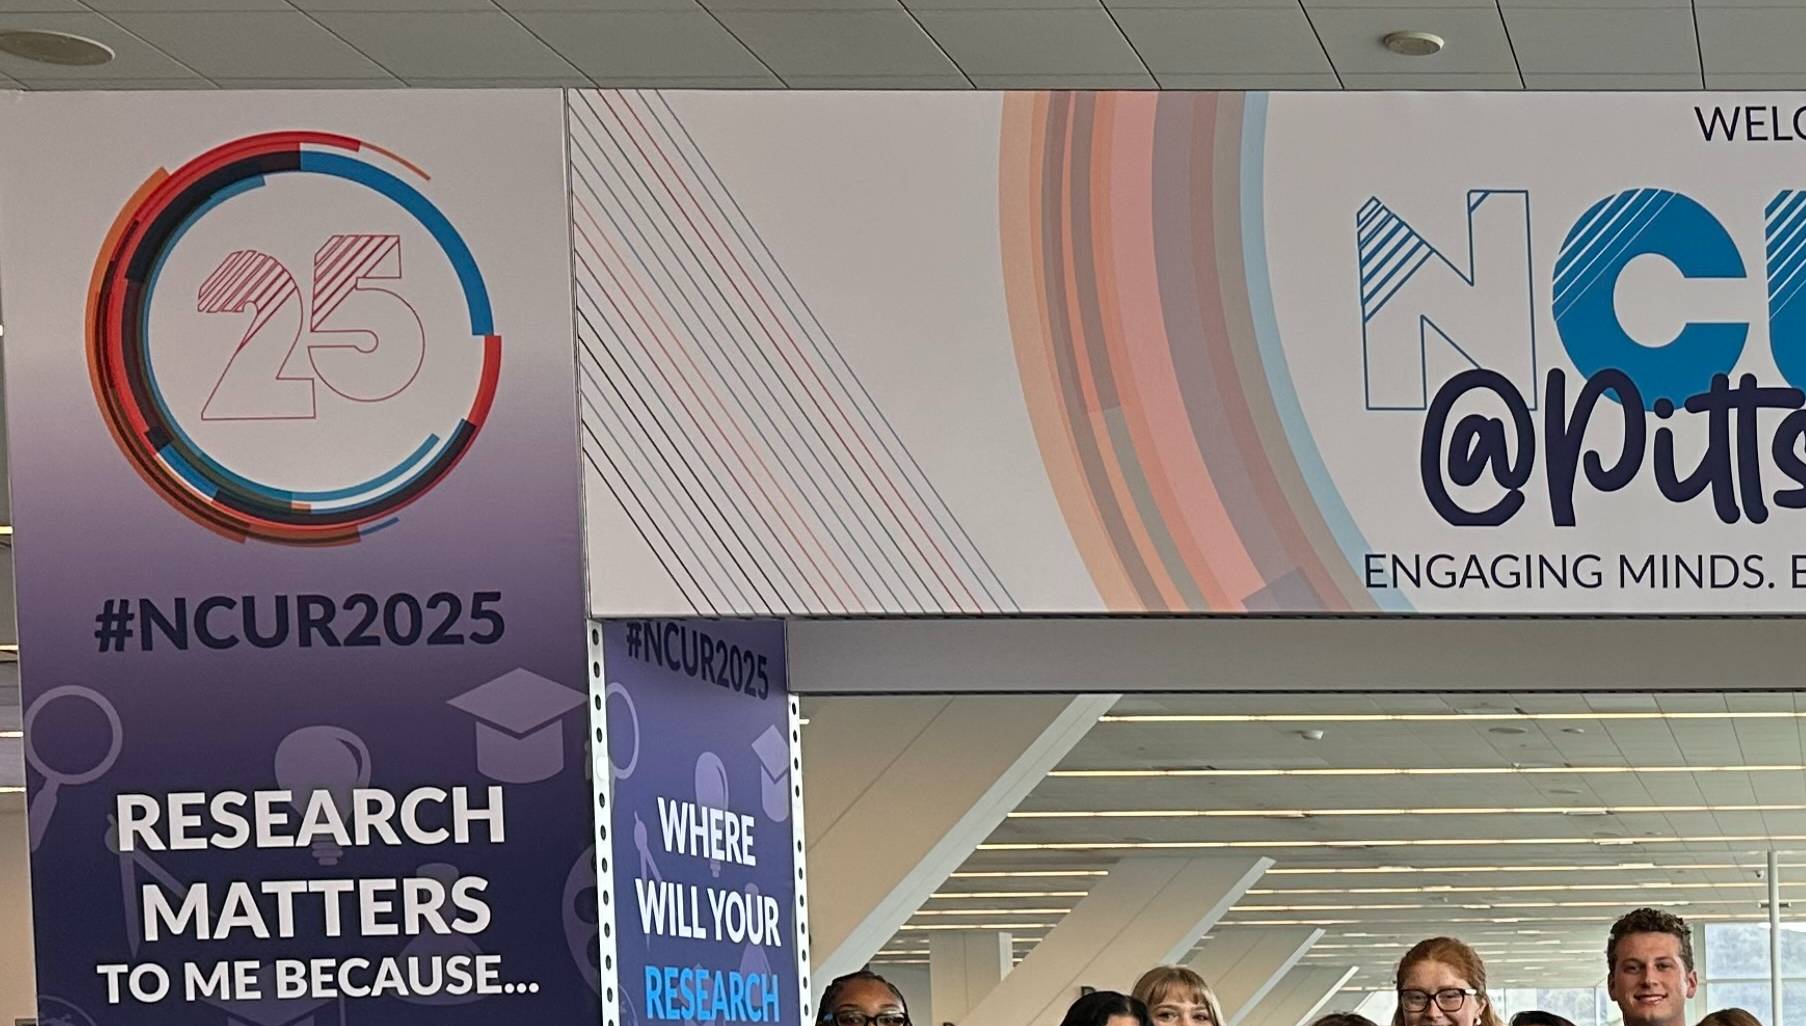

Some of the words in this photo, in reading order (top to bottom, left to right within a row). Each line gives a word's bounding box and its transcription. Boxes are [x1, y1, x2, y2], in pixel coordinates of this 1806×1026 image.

[197, 234, 426, 422] 25
[1363, 551, 1604, 592] ENGAGING
[1615, 551, 1777, 590] MINDS.
[93, 591, 506, 653] #NCUR2025
[625, 620, 770, 701] #NCUR2025
[116, 784, 507, 852] RESEARCH
[656, 796, 757, 867] WHERE
[142, 875, 492, 943] MATTERS
[634, 877, 707, 940] WILL
[707, 887, 782, 947] YOUR
[96, 962, 171, 1004] TO
[183, 960, 263, 1002] ME
[275, 954, 541, 1000] BECAUSE...
[644, 964, 781, 1023] RESEARCH
